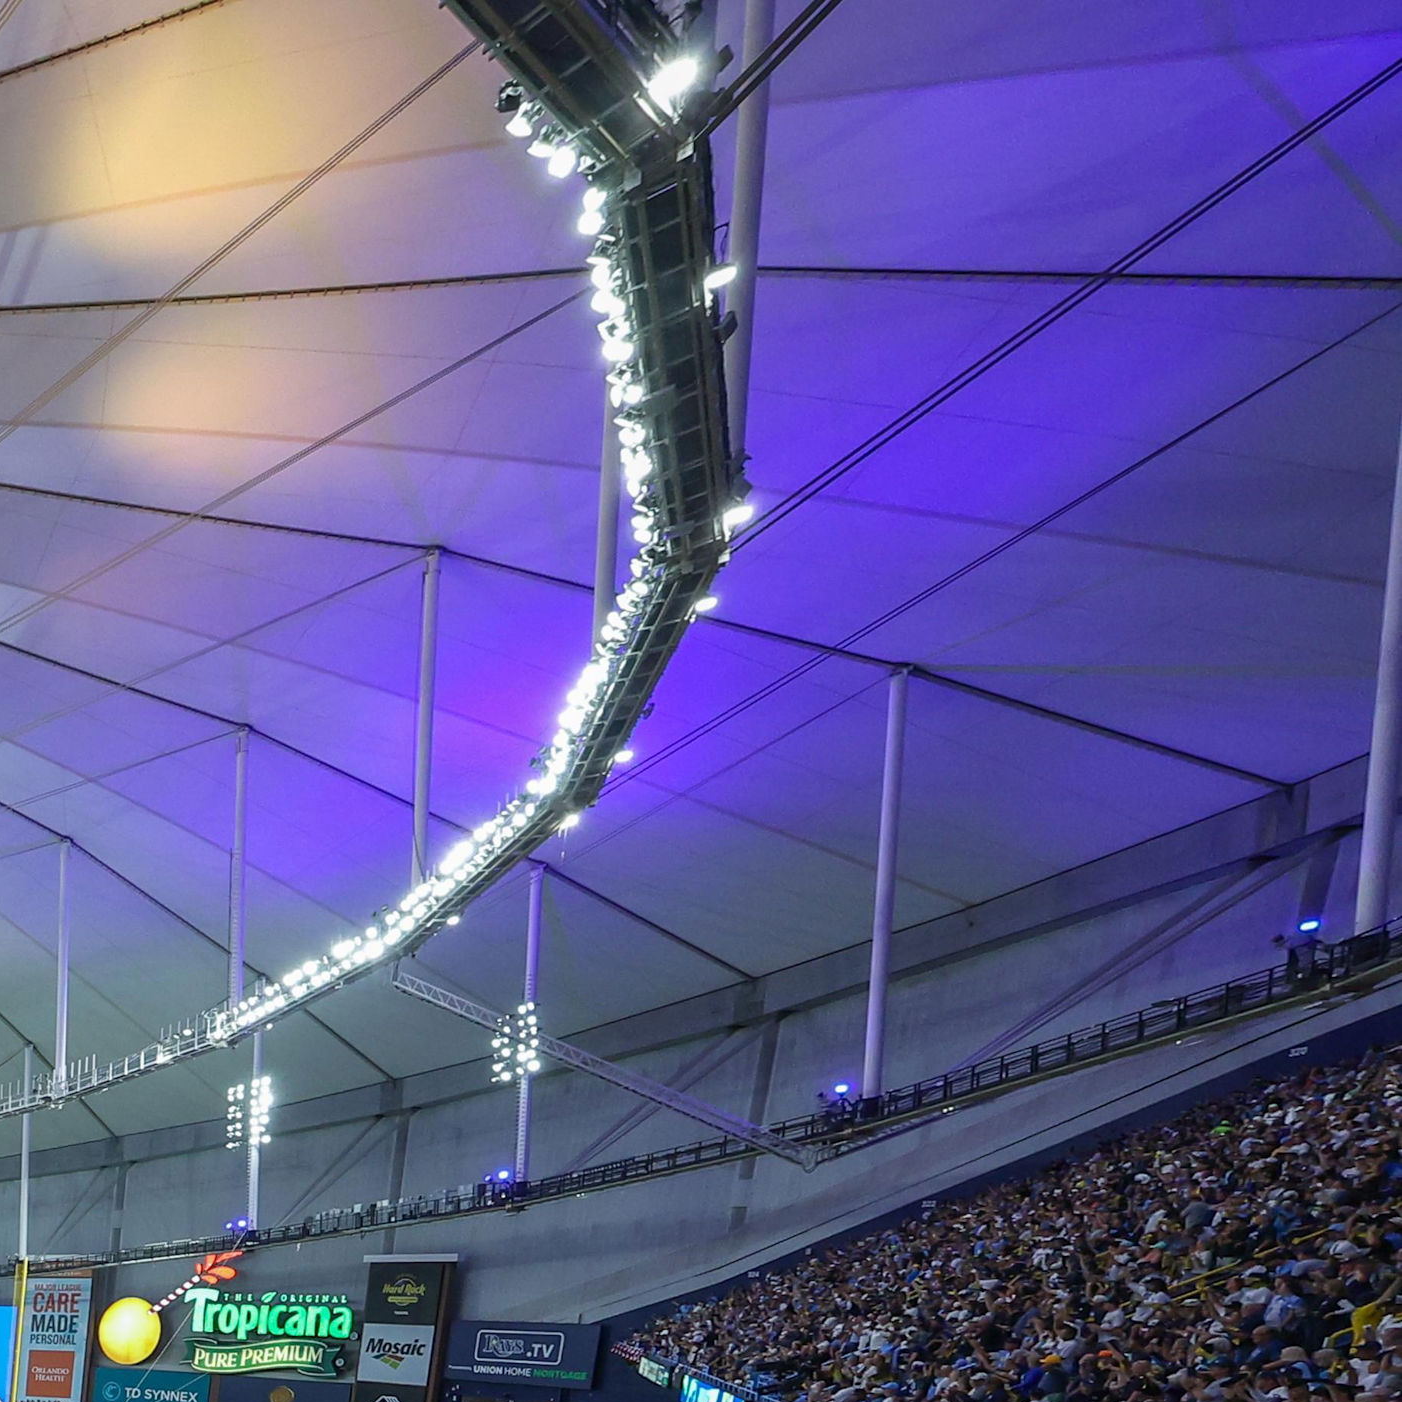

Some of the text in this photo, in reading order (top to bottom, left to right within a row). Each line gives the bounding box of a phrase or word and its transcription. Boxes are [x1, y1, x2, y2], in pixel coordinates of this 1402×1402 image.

[34, 1283, 82, 1292] MAJOR LEAGUE
[382, 1283, 426, 1296] Hard Rock
[33, 1292, 82, 1313] CARE
[223, 1292, 348, 1304] THE ORIGINAL
[184, 1287, 353, 1340] Tropicana
[31, 1314, 79, 1334] MADE
[29, 1333, 77, 1345] PERSONAL
[365, 1337, 426, 1356] Mosaic
[194, 1345, 324, 1367] PURE PREMIUM
[31, 1366, 70, 1375] ORLANDO
[35, 1373, 65, 1382] HEALTH
[473, 1366, 587, 1381] UNION HOME MORTGAGE
[125, 1387, 198, 1402] TD SYNNEX
